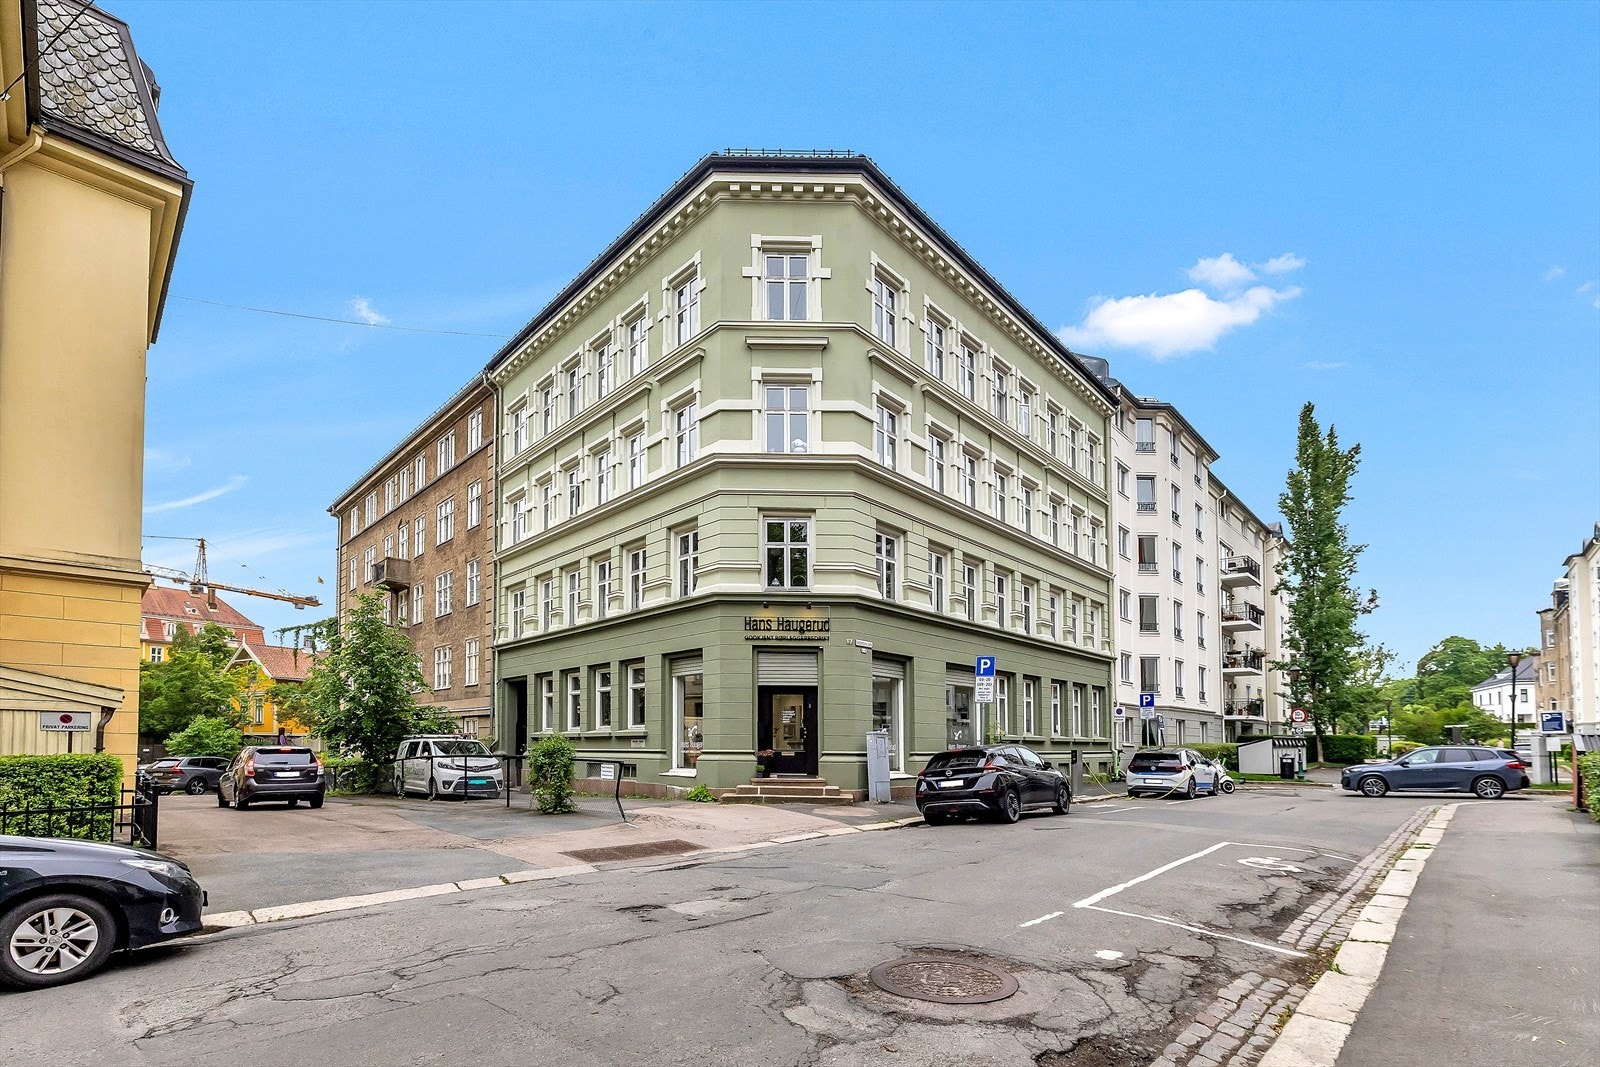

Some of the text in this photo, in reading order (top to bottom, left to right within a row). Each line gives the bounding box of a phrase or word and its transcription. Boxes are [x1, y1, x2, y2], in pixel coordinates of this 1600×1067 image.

[744, 616, 830, 634] Hans Haugerud
[980, 658, 991, 674] P
[1142, 695, 1152, 706] P
